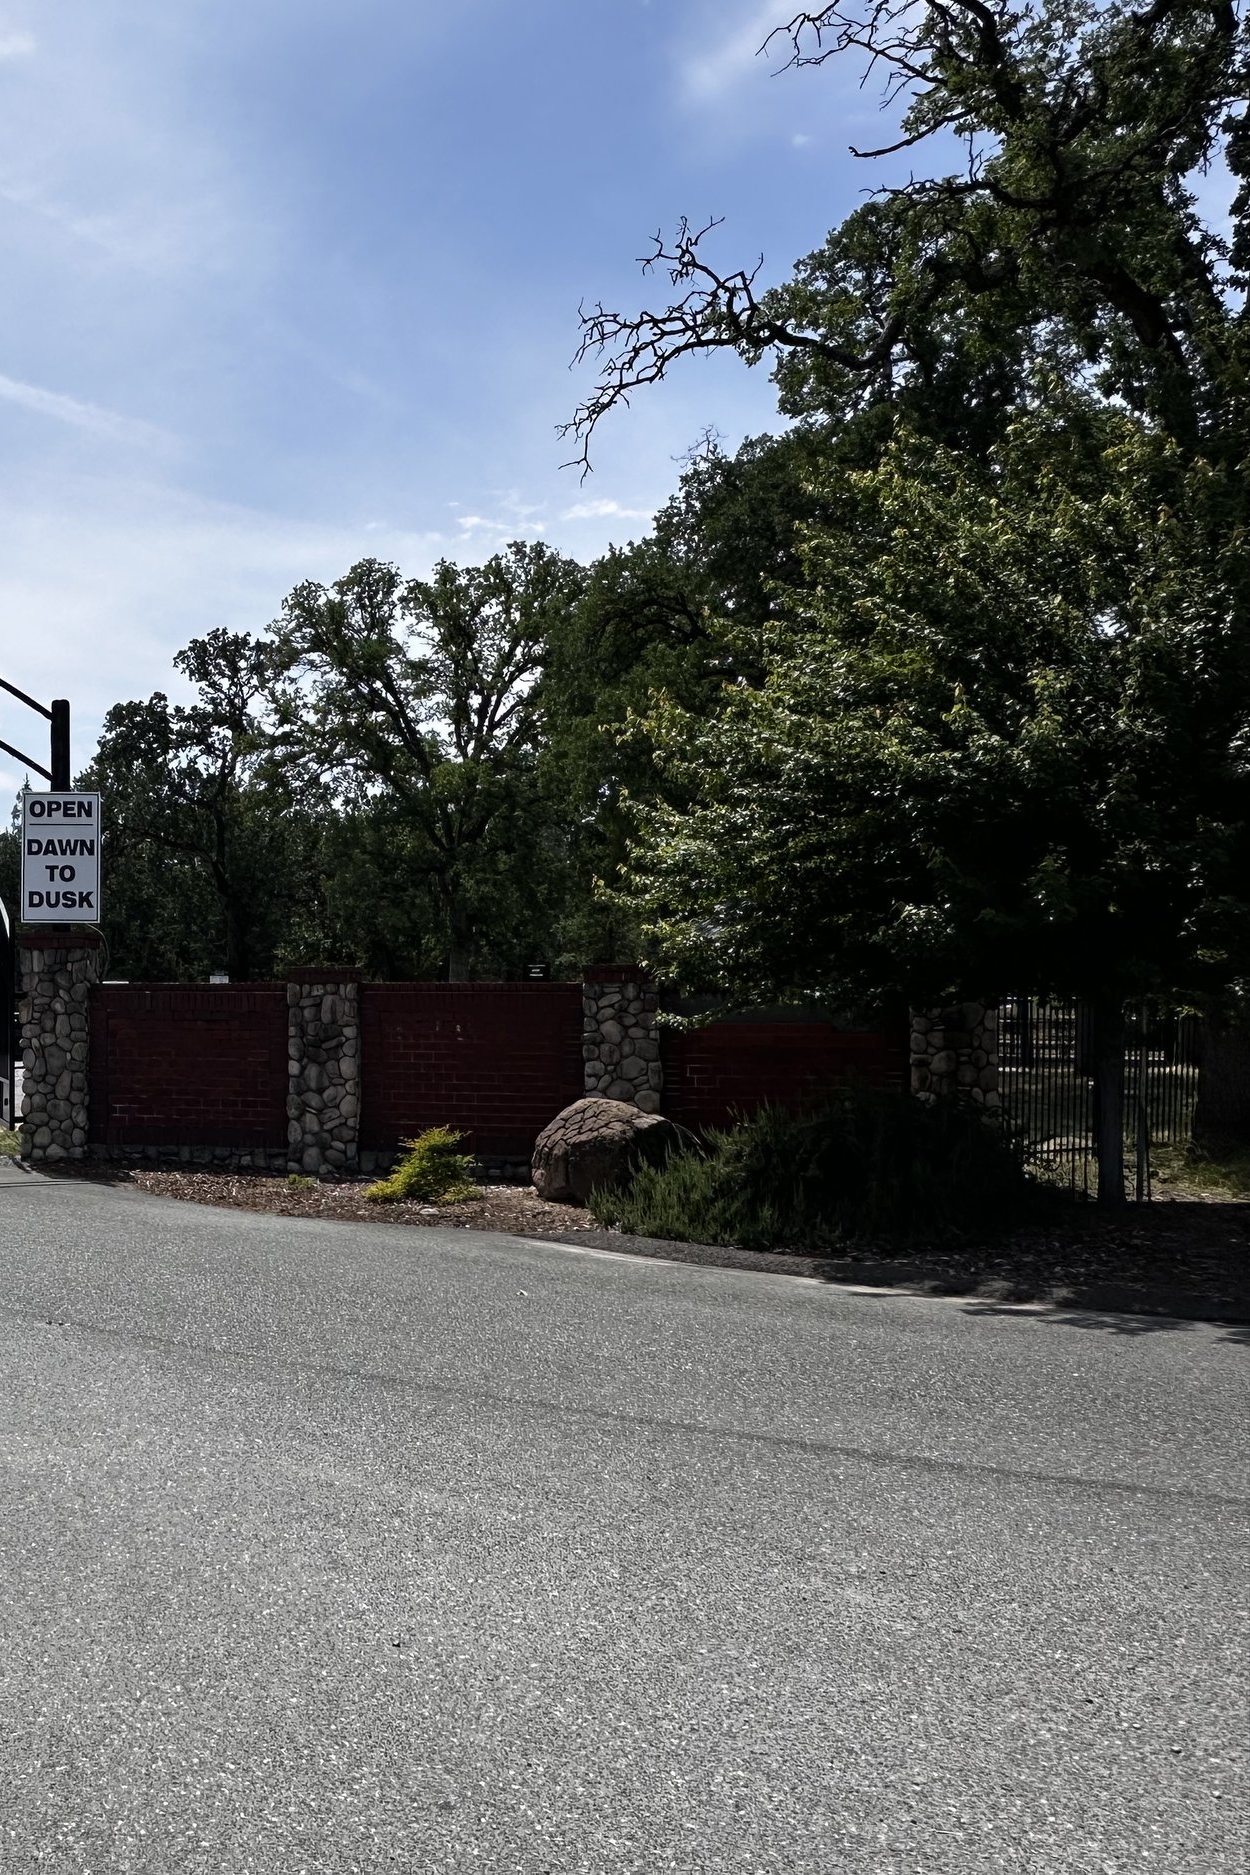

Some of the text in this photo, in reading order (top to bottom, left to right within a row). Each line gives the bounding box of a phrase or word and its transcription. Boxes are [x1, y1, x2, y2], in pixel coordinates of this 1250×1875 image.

[29, 800, 93, 818] OPEN
[27, 838, 95, 856] DAWN
[45, 864, 76, 883] TO
[28, 890, 95, 909] DUSK
